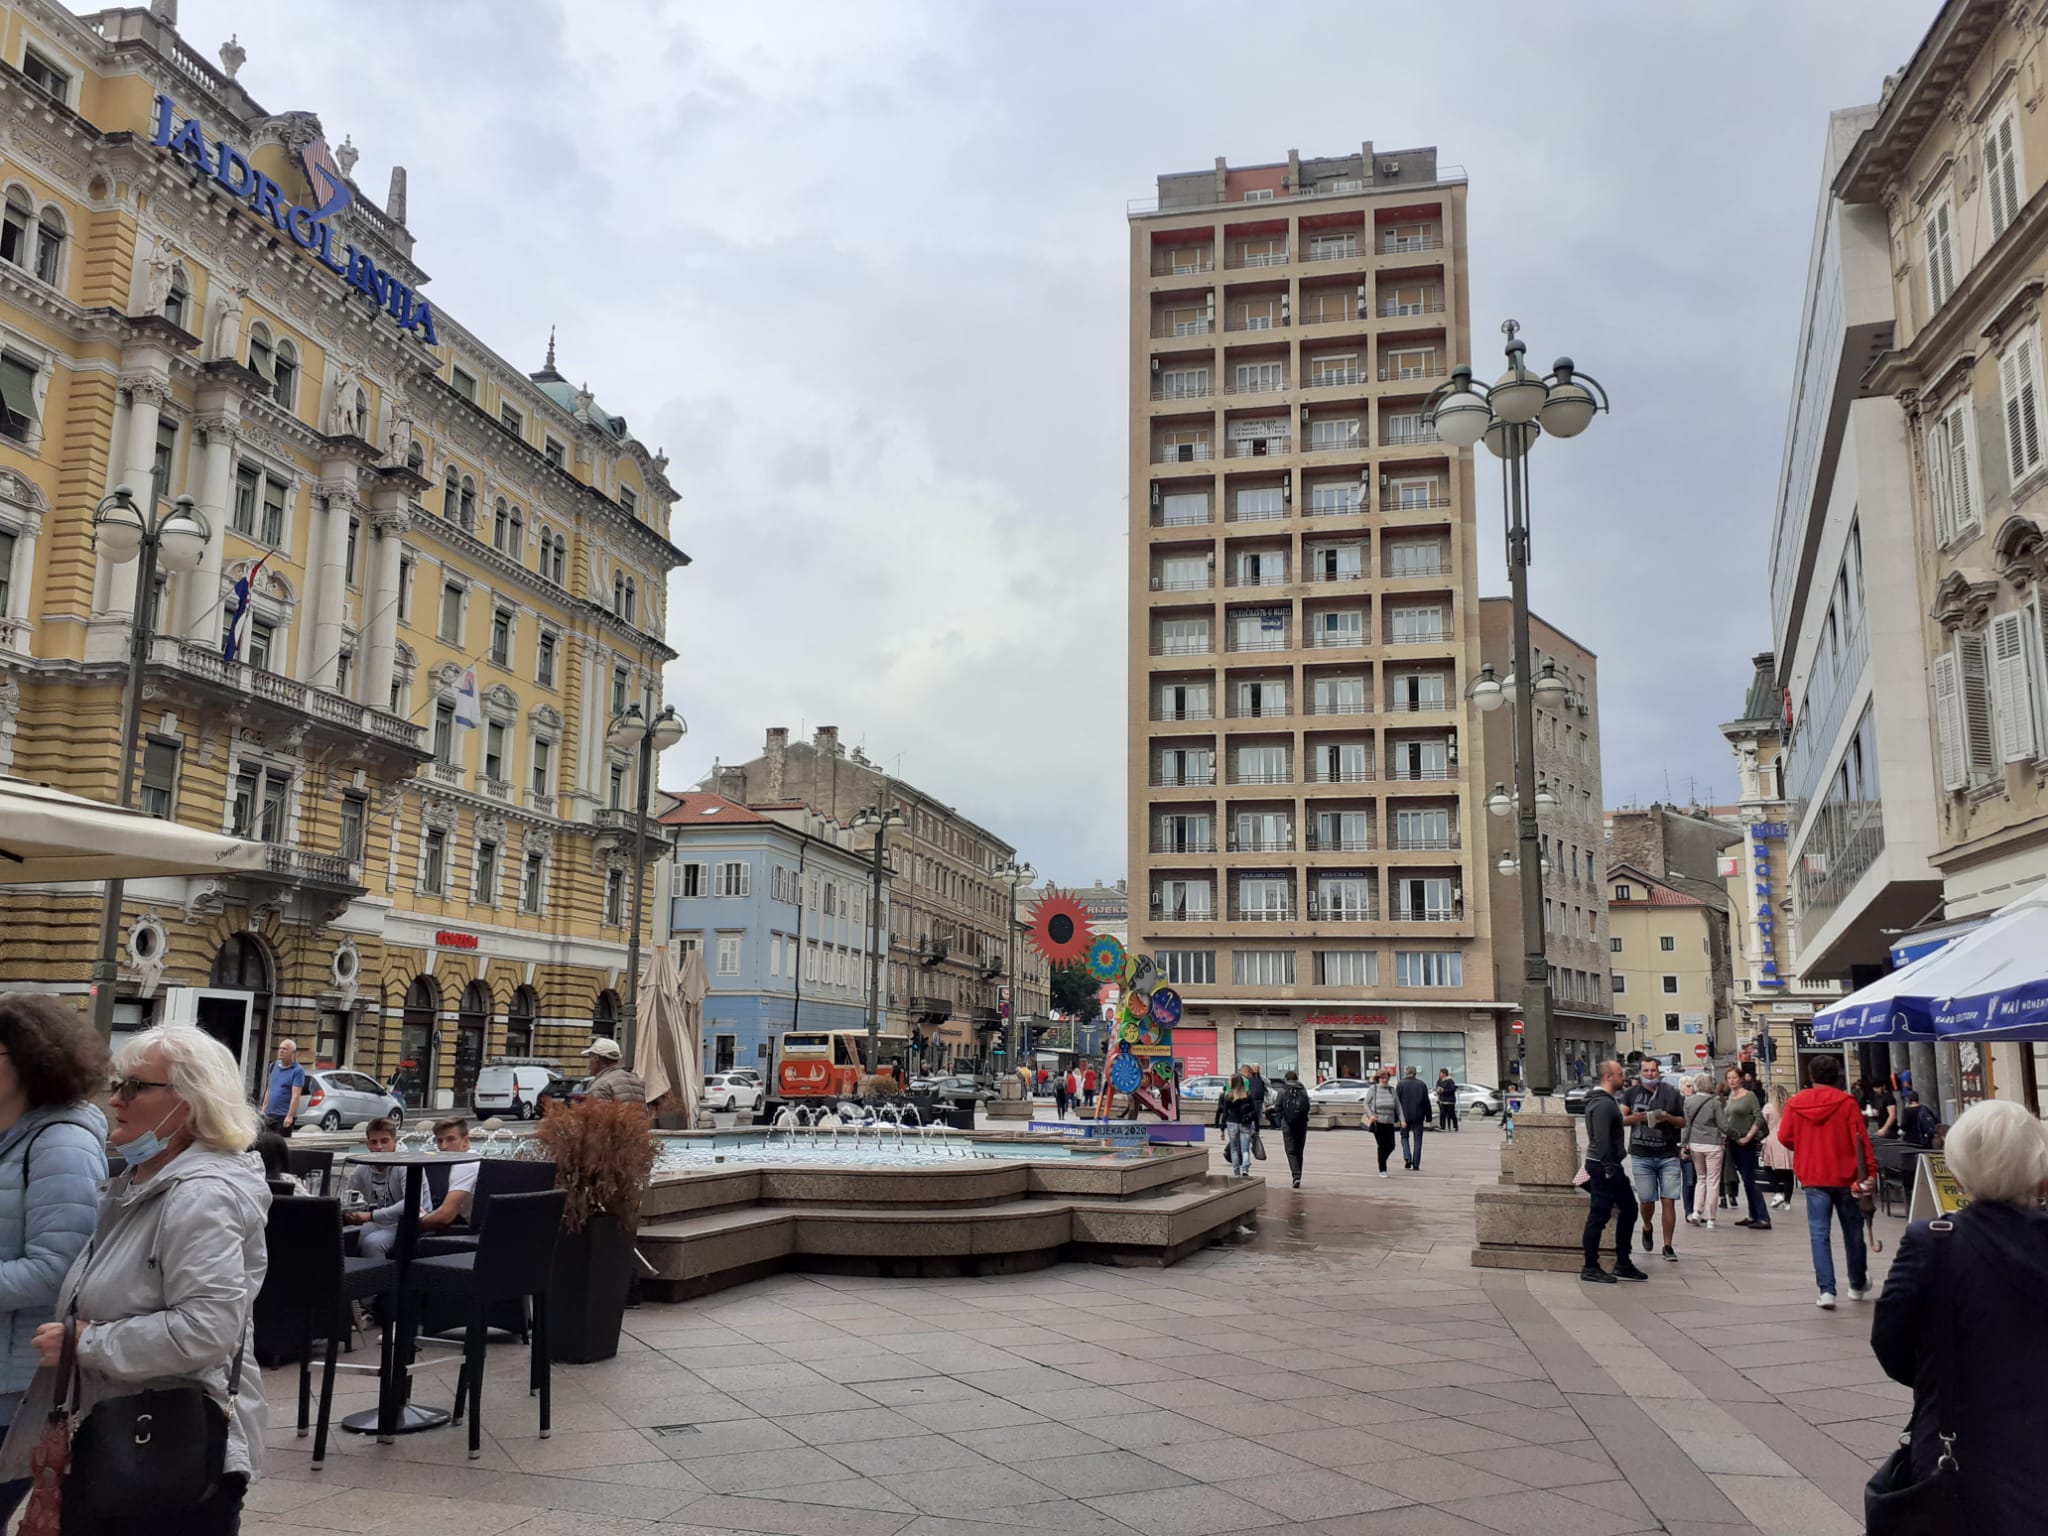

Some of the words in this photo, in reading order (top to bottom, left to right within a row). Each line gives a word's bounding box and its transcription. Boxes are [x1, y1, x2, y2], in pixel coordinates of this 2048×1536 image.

[151, 95, 438, 346] JADROLINIJA
[1754, 844, 1778, 975] BONAVIA
[1093, 1125, 1123, 1136] RIJEKA
[1125, 1126, 1147, 1136] 2020
